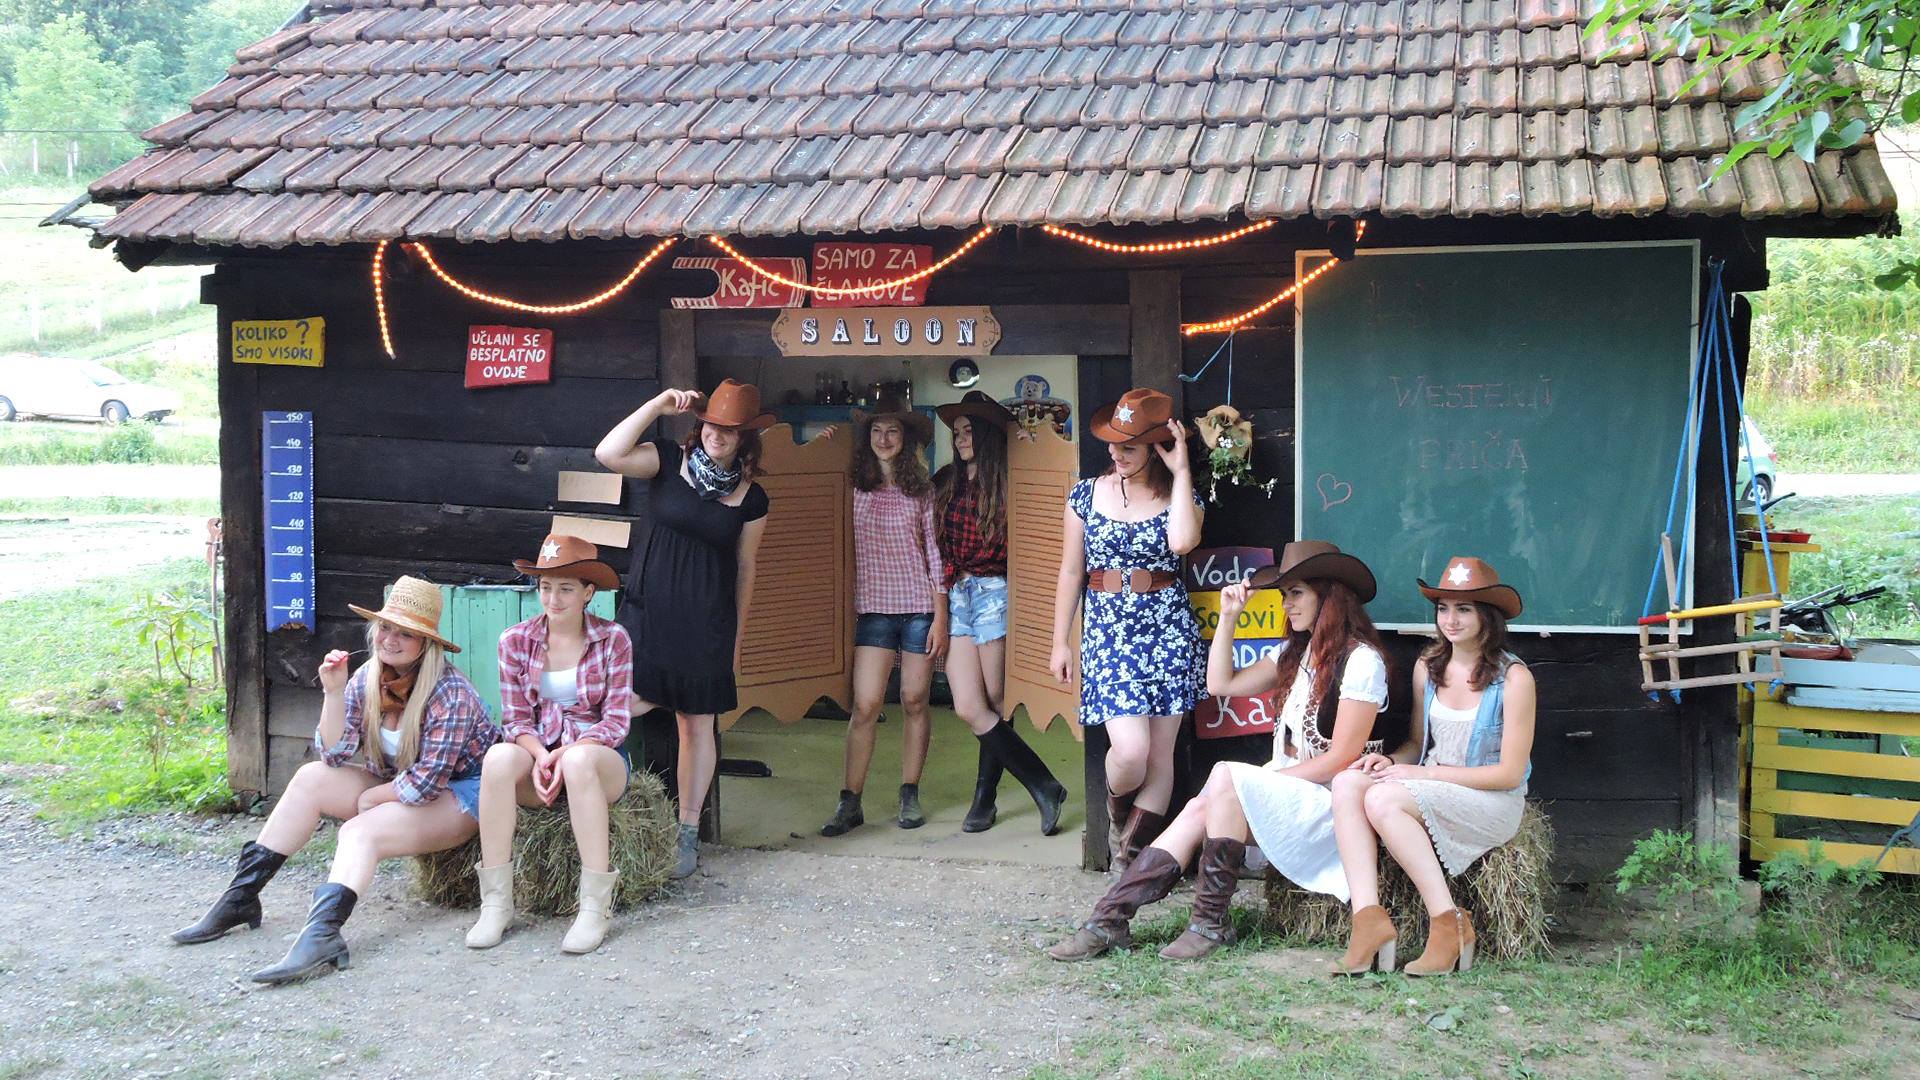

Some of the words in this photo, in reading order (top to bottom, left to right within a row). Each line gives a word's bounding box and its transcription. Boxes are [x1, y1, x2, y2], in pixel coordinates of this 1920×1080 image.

[816, 247, 875, 270] SAMO
[886, 249, 917, 270] ZA
[236, 327, 288, 341] KOLIKO
[295, 320, 310, 345] ?
[472, 330, 515, 346] UČLANI
[523, 334, 541, 347] SE
[801, 318, 977, 345] SALOON
[236, 345, 263, 359] SMO
[268, 347, 313, 360] VISOKI
[470, 347, 546, 363] BESPLATNO
[483, 365, 528, 378] OVDJE
[286, 412, 303, 421] 150
[287, 465, 302, 475] 130
[288, 491, 304, 501] 120
[286, 545, 303, 554] 100
[290, 572, 303, 581] 90
[290, 598, 304, 608] 80
[1195, 605, 1275, 630] Soovi
